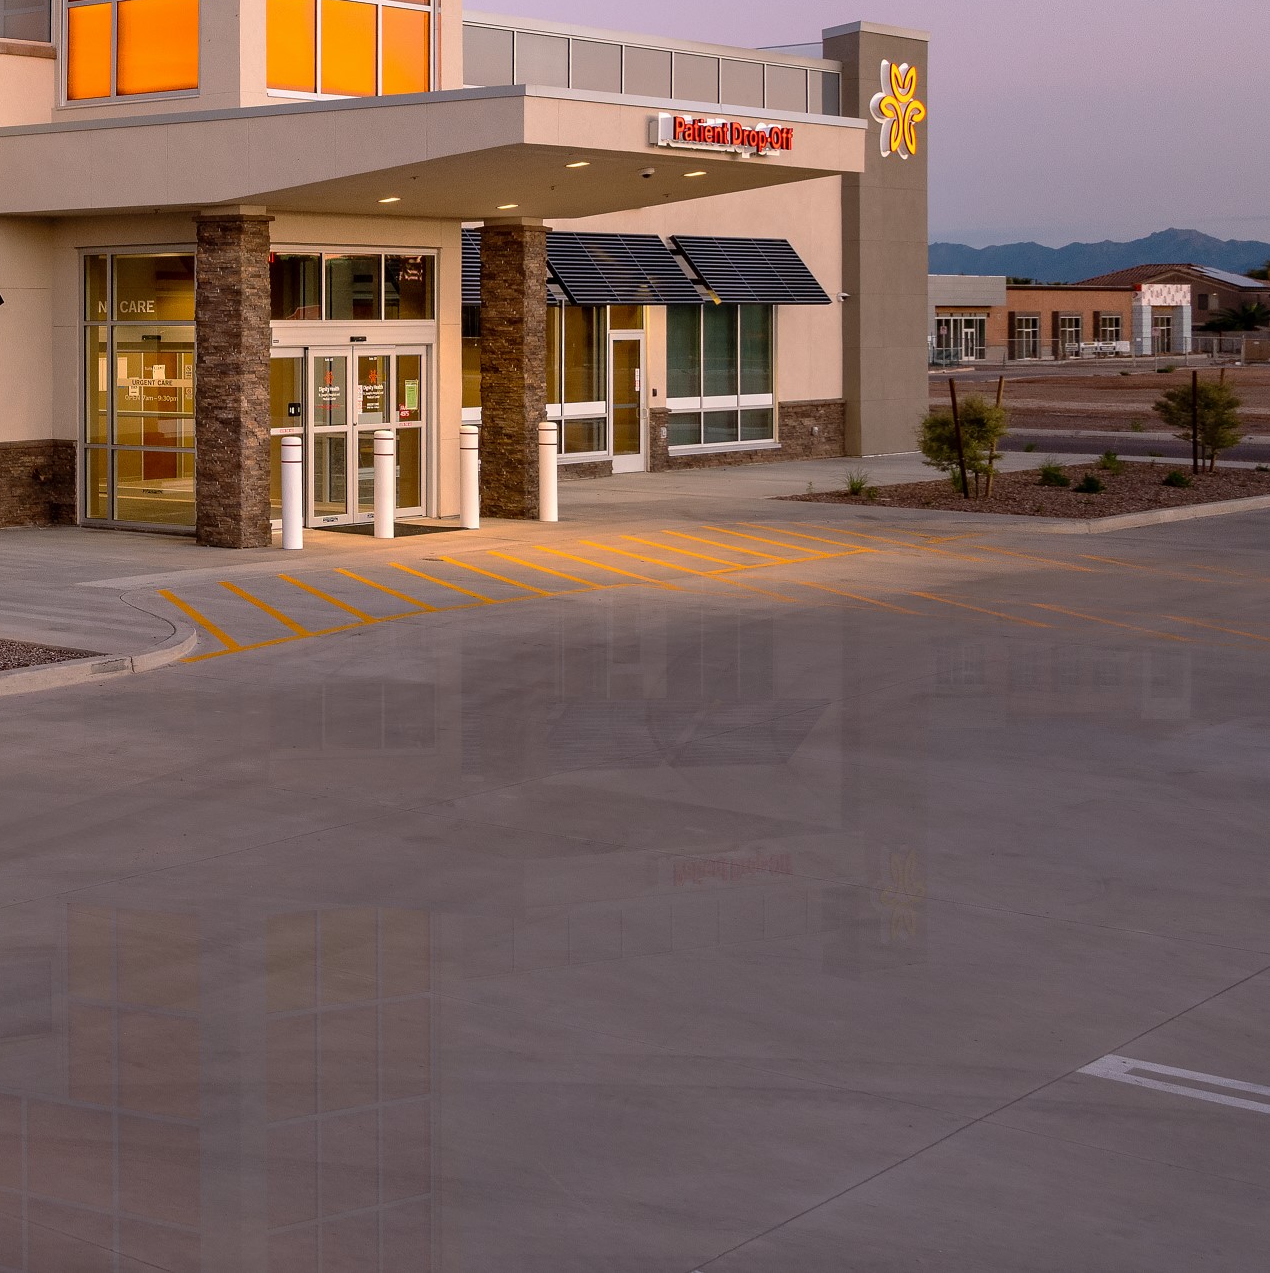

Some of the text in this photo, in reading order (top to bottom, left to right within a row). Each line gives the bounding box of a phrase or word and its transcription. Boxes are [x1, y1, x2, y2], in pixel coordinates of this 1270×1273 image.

[674, 116, 793, 153] Patient Drop-Off
[119, 300, 155, 313] CARE
